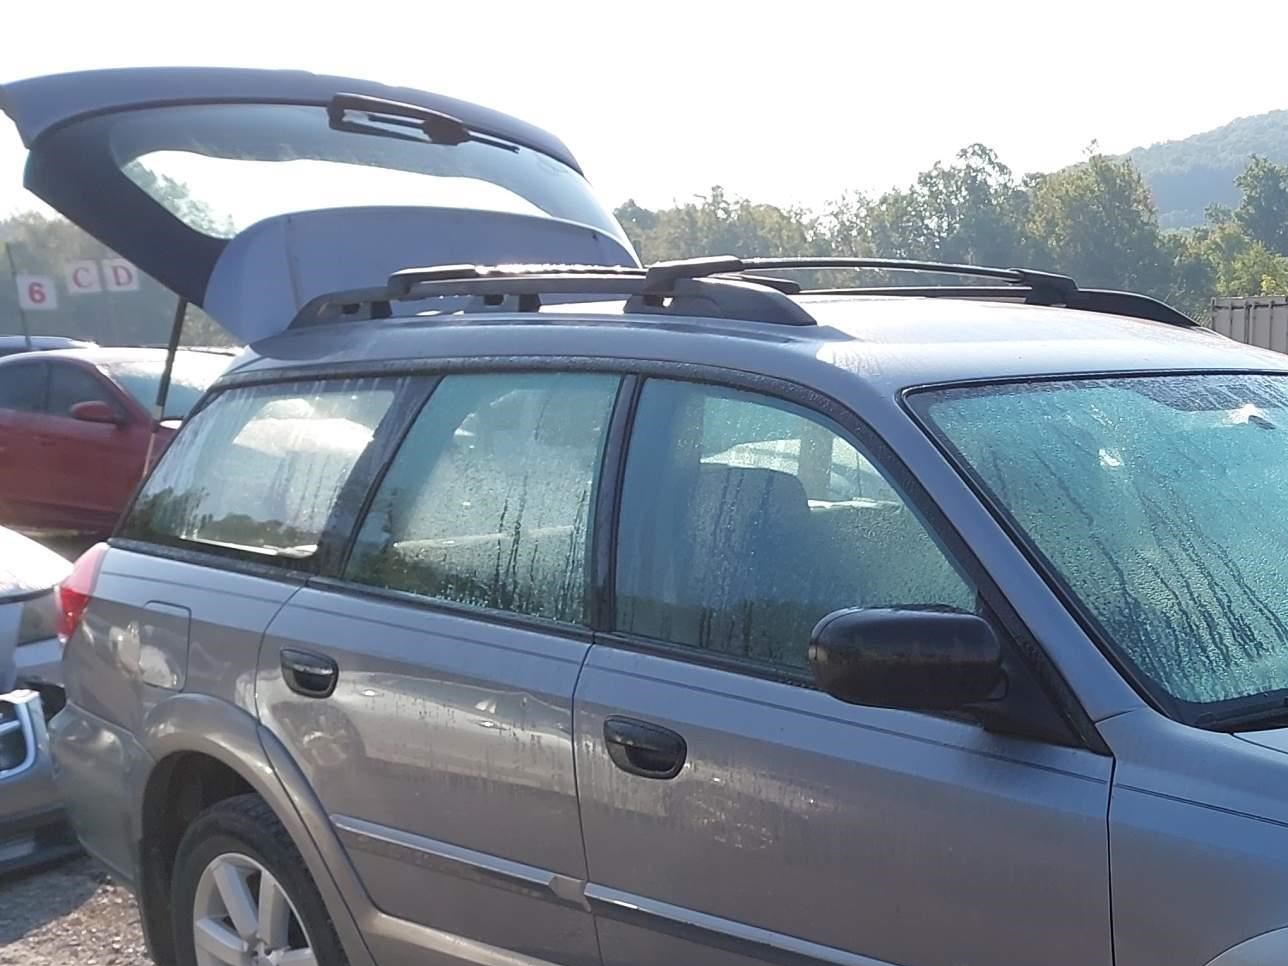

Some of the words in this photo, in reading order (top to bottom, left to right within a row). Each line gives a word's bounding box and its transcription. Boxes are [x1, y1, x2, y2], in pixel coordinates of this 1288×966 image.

[73, 267, 94, 288] C
[112, 265, 133, 287] D
[28, 282, 46, 304] 6
